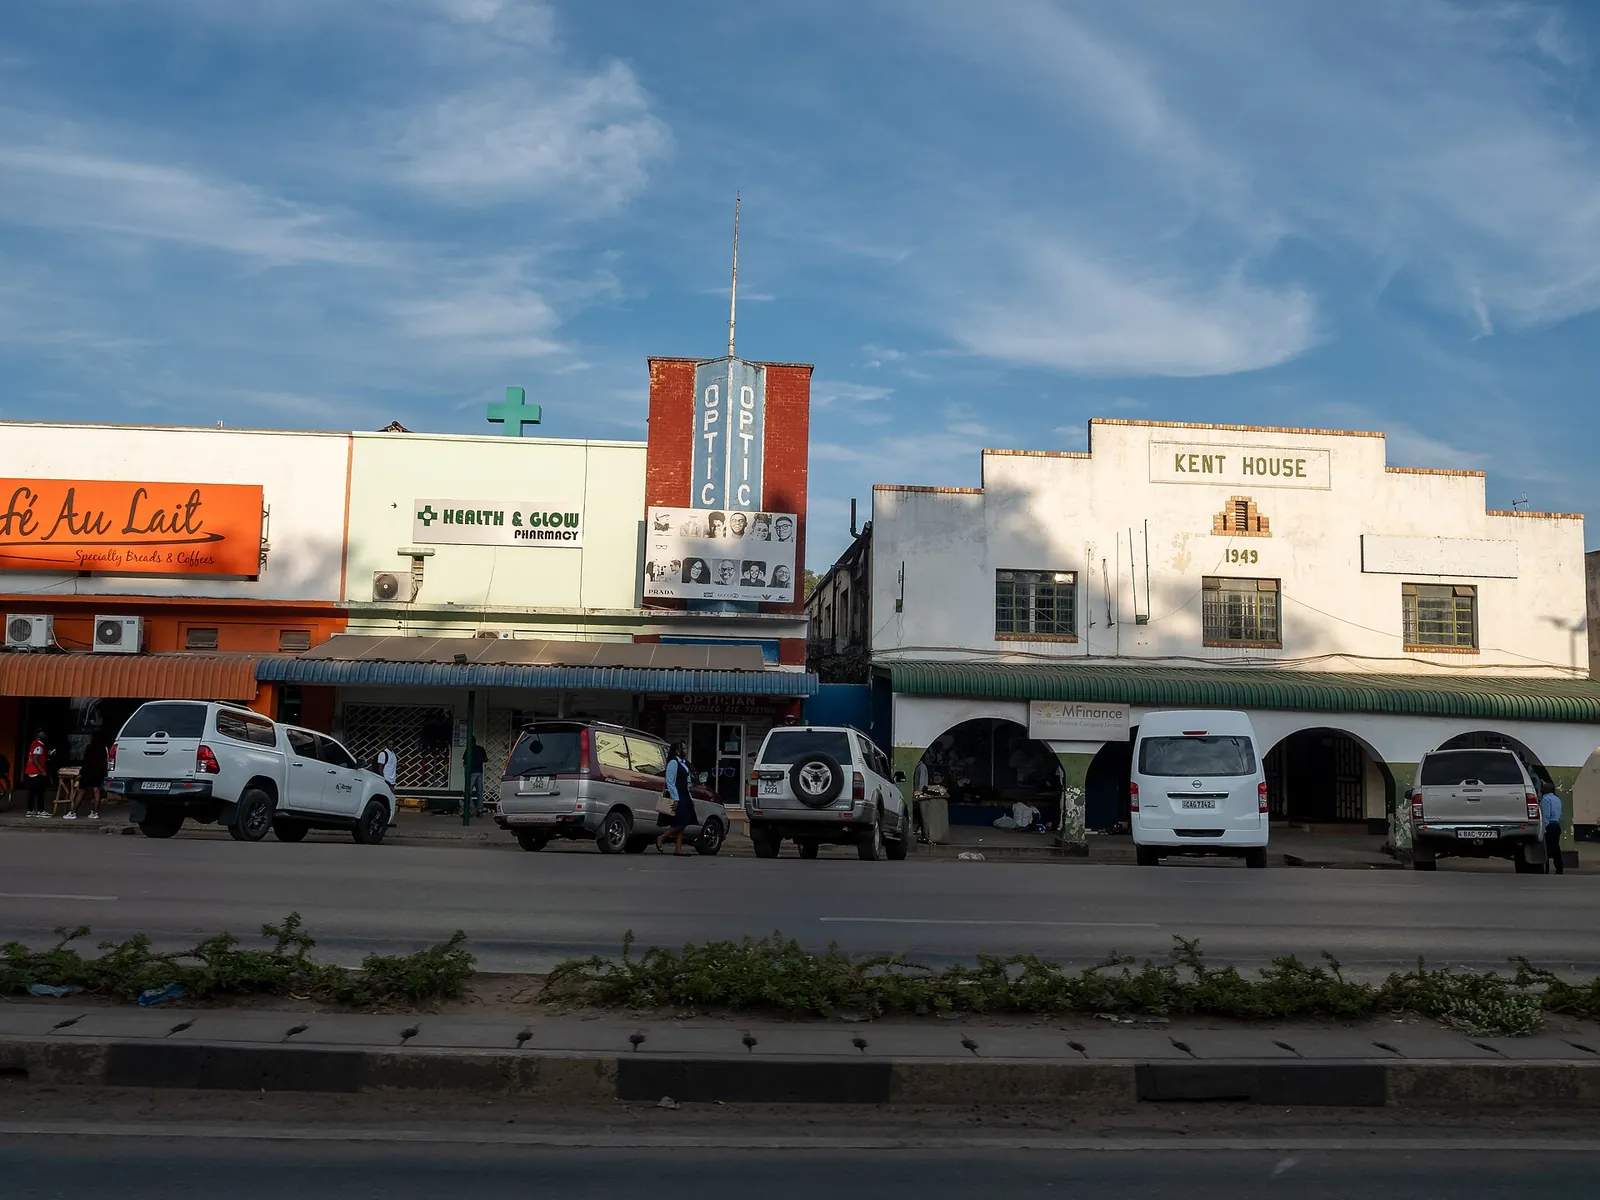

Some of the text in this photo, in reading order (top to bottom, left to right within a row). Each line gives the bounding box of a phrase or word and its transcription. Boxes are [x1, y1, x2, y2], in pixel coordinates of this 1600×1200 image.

[701, 384, 719, 505] OPTIC
[737, 385, 755, 506] OPTIC
[1175, 453, 1307, 478] KENT HOUSE
[0, 487, 203, 540] fé Au Lait
[443, 509, 580, 529] HEALTH & GLOW
[514, 529, 579, 541] PHARMACY
[74, 549, 215, 568] Specialty Breads & Coffees
[1225, 548, 1259, 564] 1949
[682, 695, 756, 706] OPTICIAN
[1062, 705, 1123, 719] MFinance
